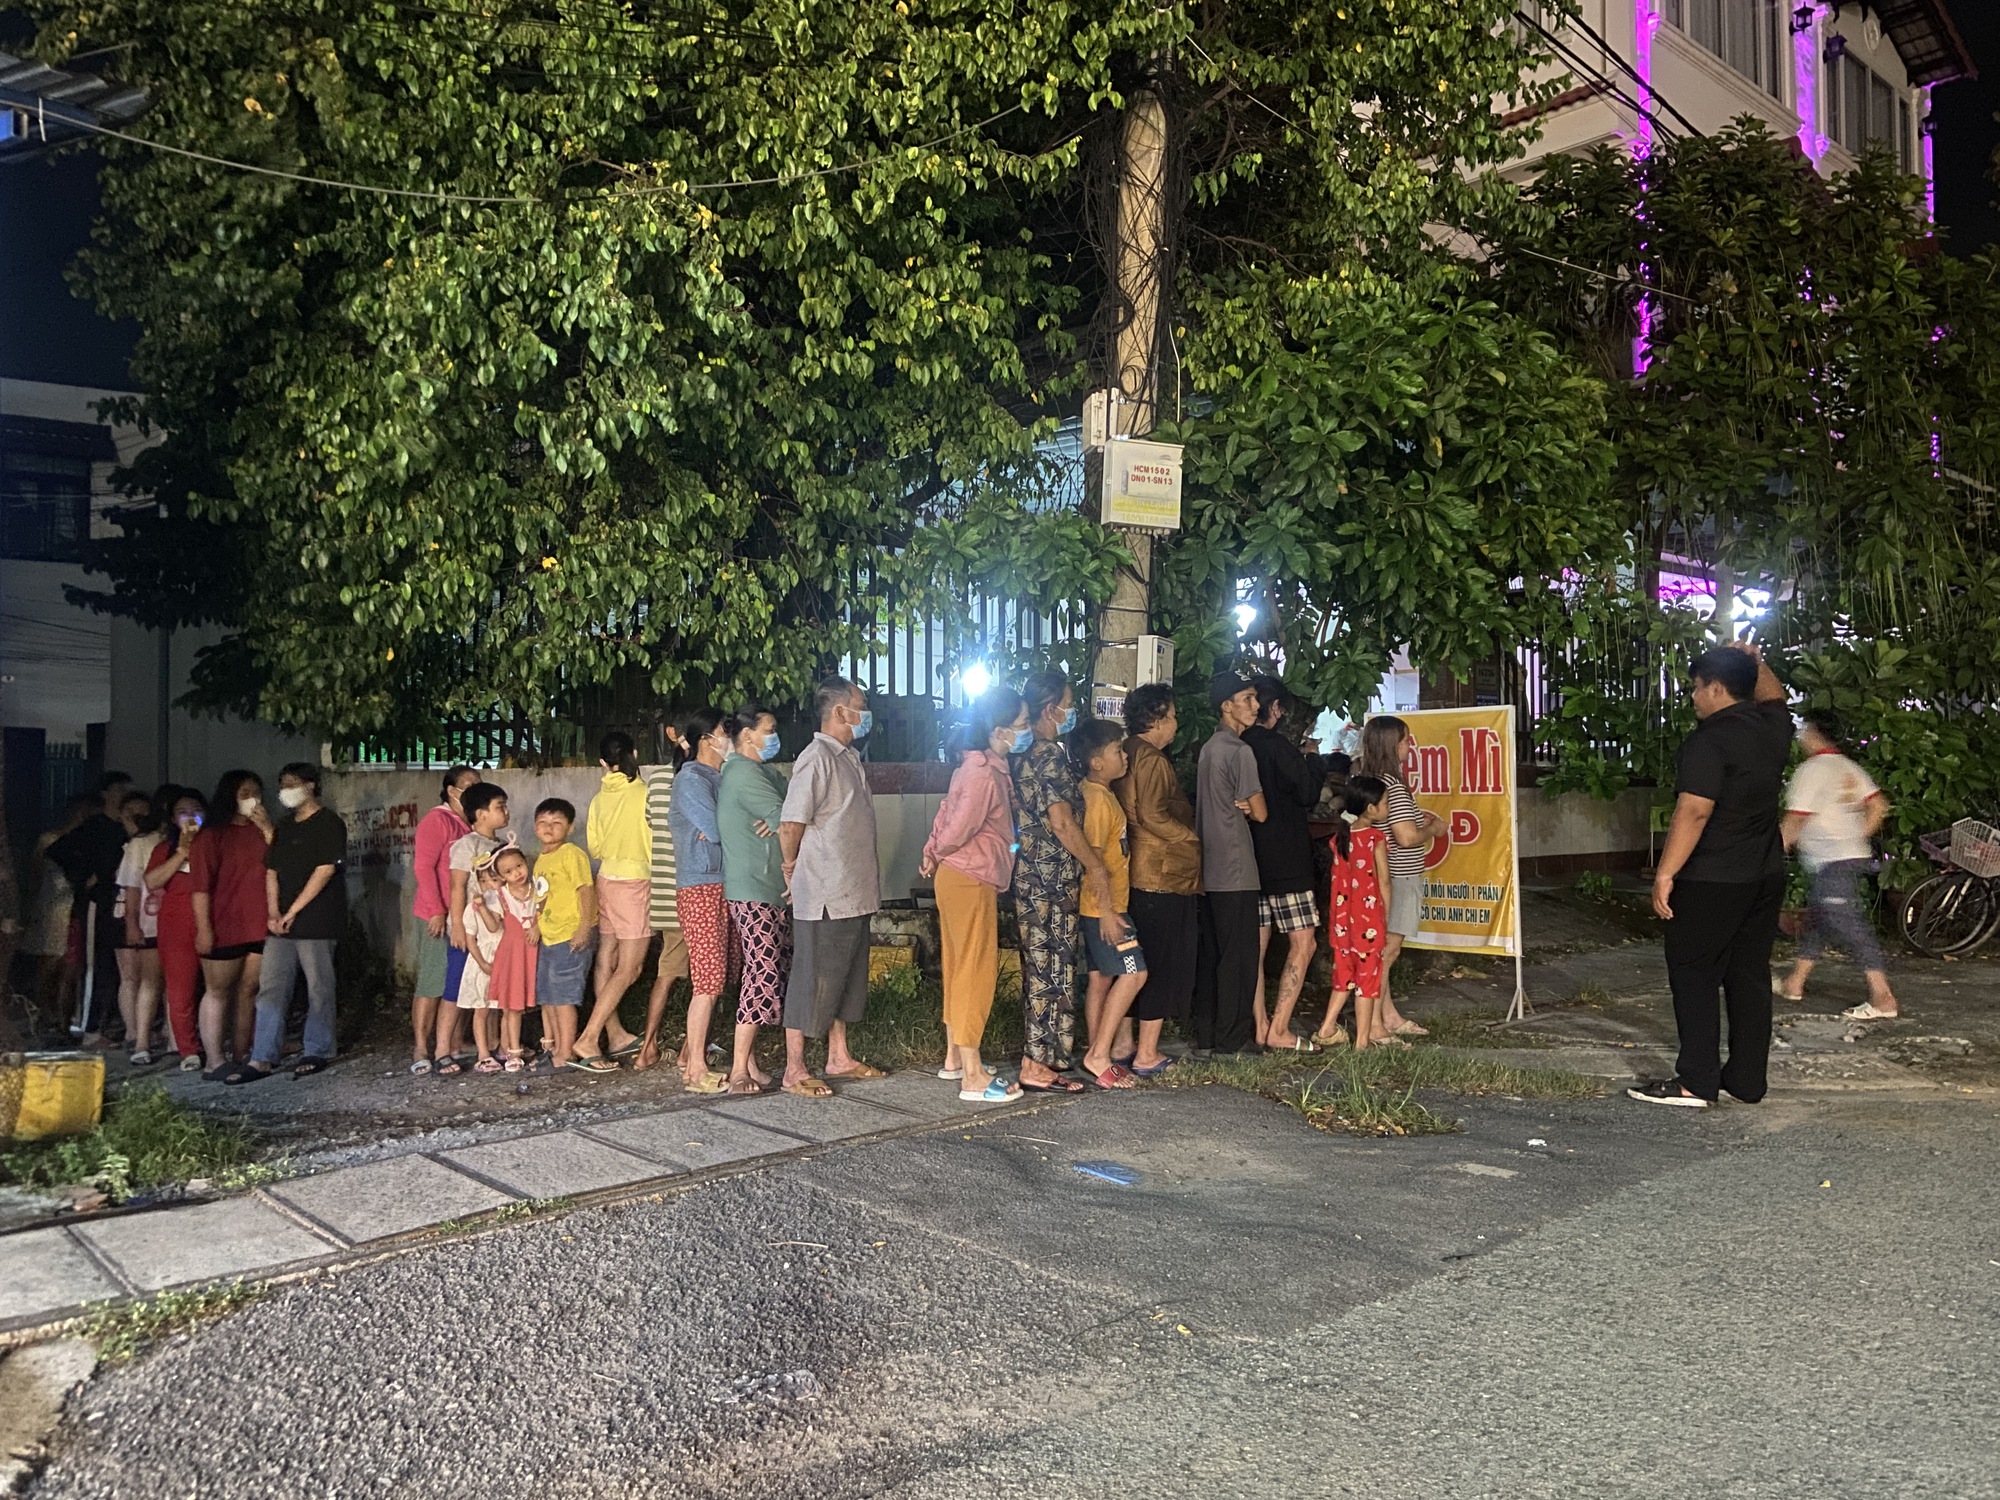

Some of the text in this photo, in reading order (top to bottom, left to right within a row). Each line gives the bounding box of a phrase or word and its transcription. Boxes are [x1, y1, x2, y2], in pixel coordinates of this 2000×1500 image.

[1134, 464, 1170, 475] HCM1502
[1131, 474, 1173, 485] DN01-SN13
[1460, 728, 1503, 793] Mì
[1471, 886, 1475, 900] 1
[1448, 907, 1463, 922] ANH
[1480, 909, 1490, 923] EM
